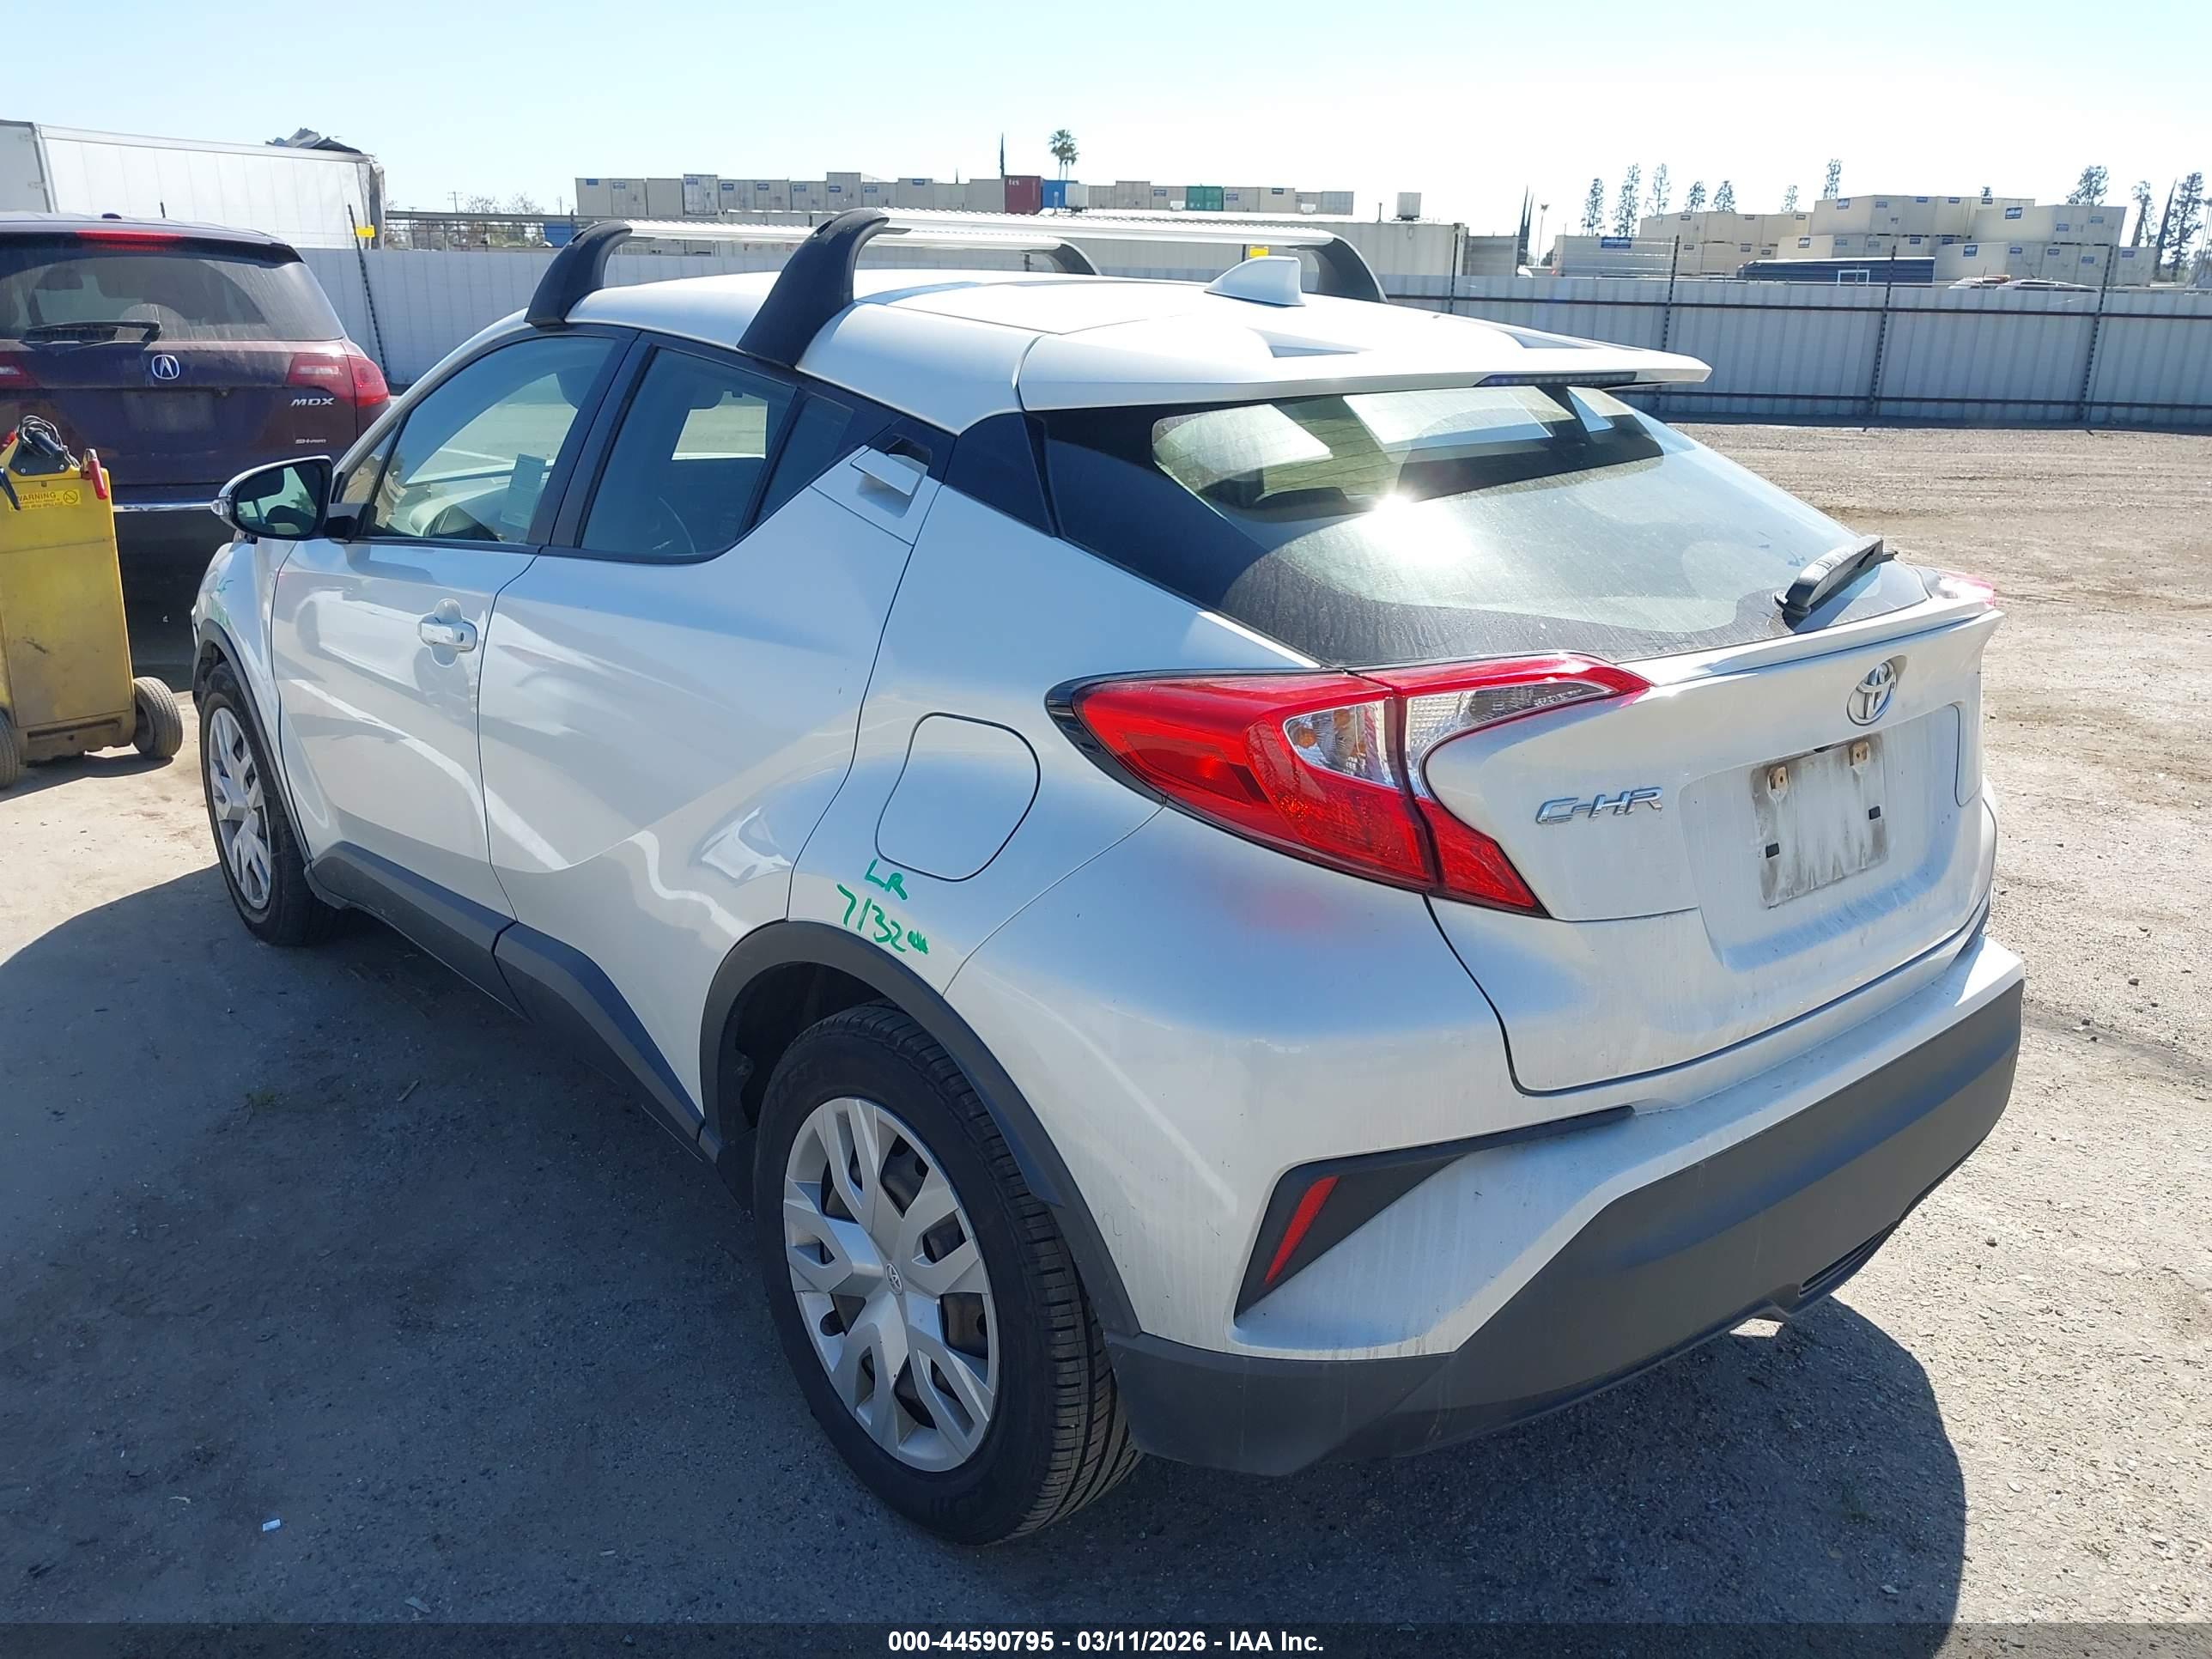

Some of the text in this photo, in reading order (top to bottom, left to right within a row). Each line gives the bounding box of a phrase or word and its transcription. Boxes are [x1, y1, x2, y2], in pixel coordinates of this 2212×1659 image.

[291, 398, 335, 406] MDX
[1535, 786, 1663, 824] C-HR
[864, 858, 908, 901] LR
